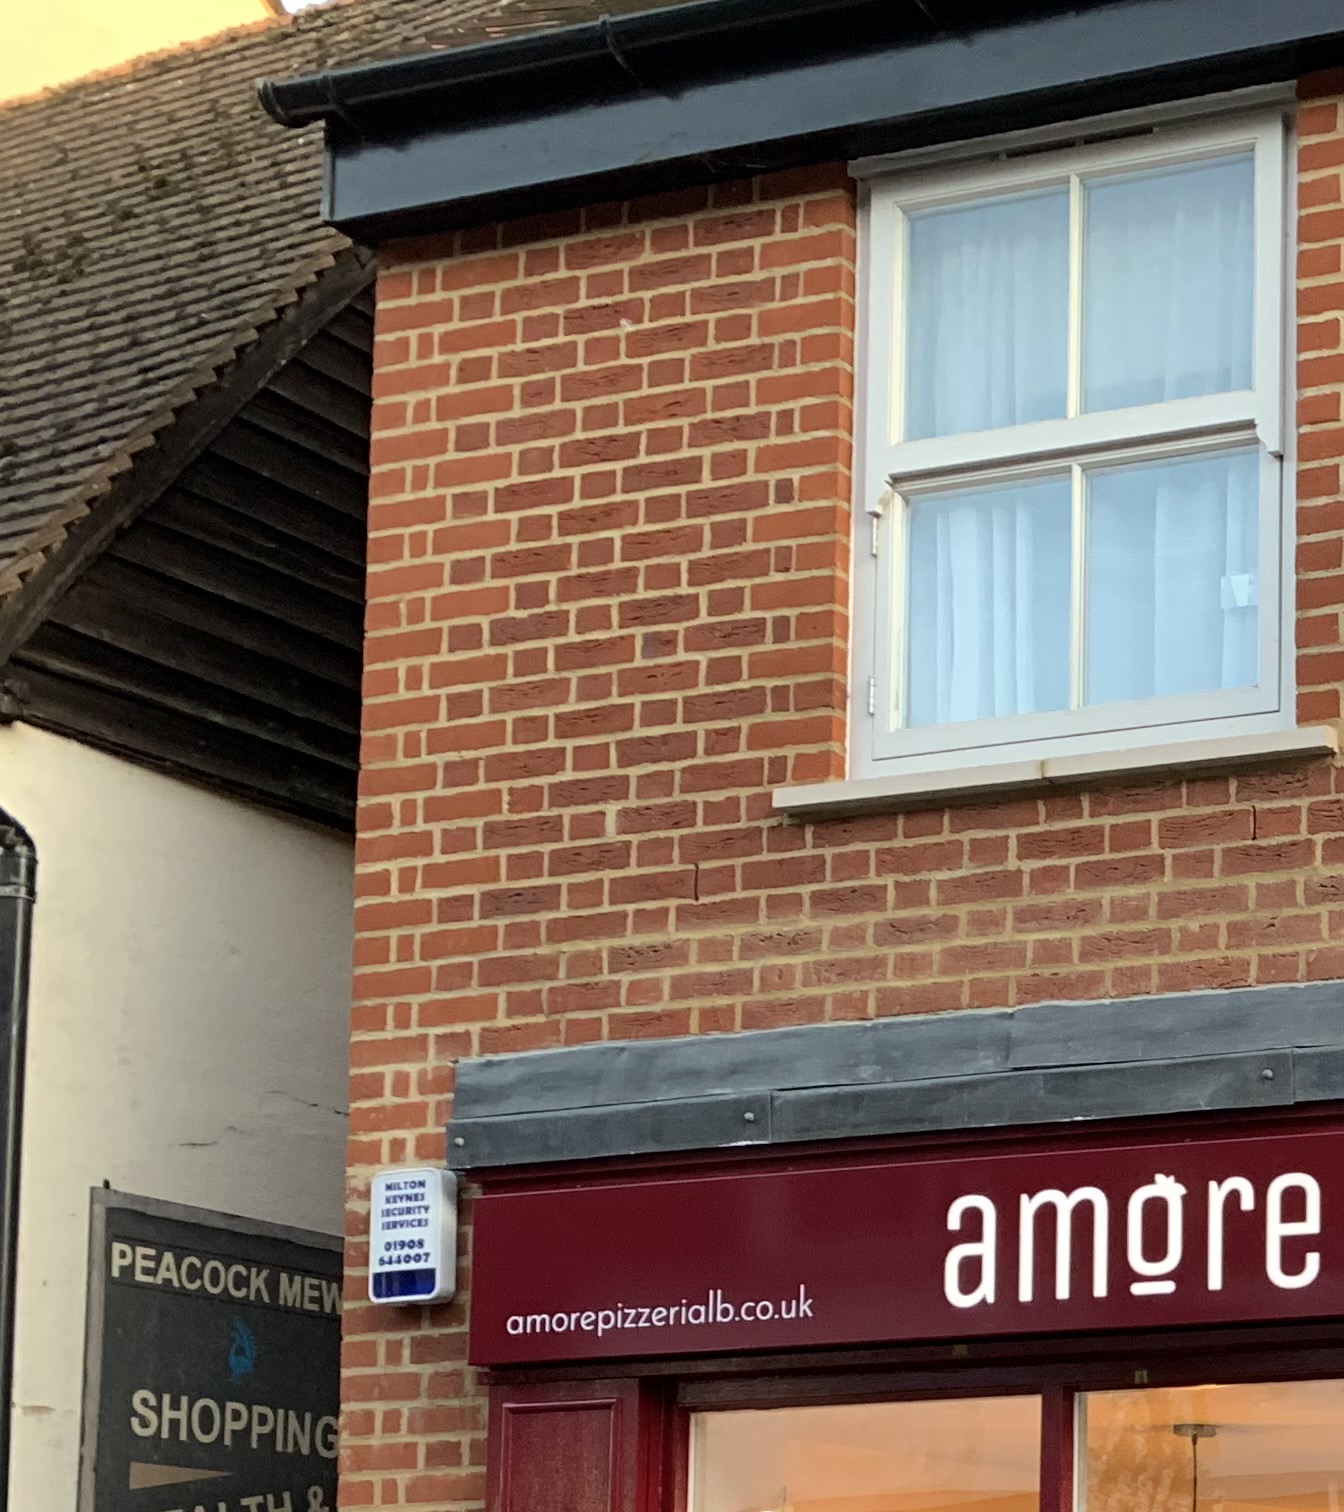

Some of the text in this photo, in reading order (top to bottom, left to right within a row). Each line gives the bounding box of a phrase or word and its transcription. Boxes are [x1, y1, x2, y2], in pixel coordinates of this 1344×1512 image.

[384, 1180, 426, 1192] MILTON
[384, 1193, 425, 1204] KEYNES
[381, 1205, 430, 1217] SECURITY
[381, 1218, 429, 1231] SERVICES
[383, 1239, 424, 1251] 01908
[943, 1171, 1322, 1309] amore
[111, 1241, 270, 1303] PEACOCK
[506, 1283, 813, 1337] amorepizzerialb.co.uk
[130, 1389, 338, 1459] SHOPPING
